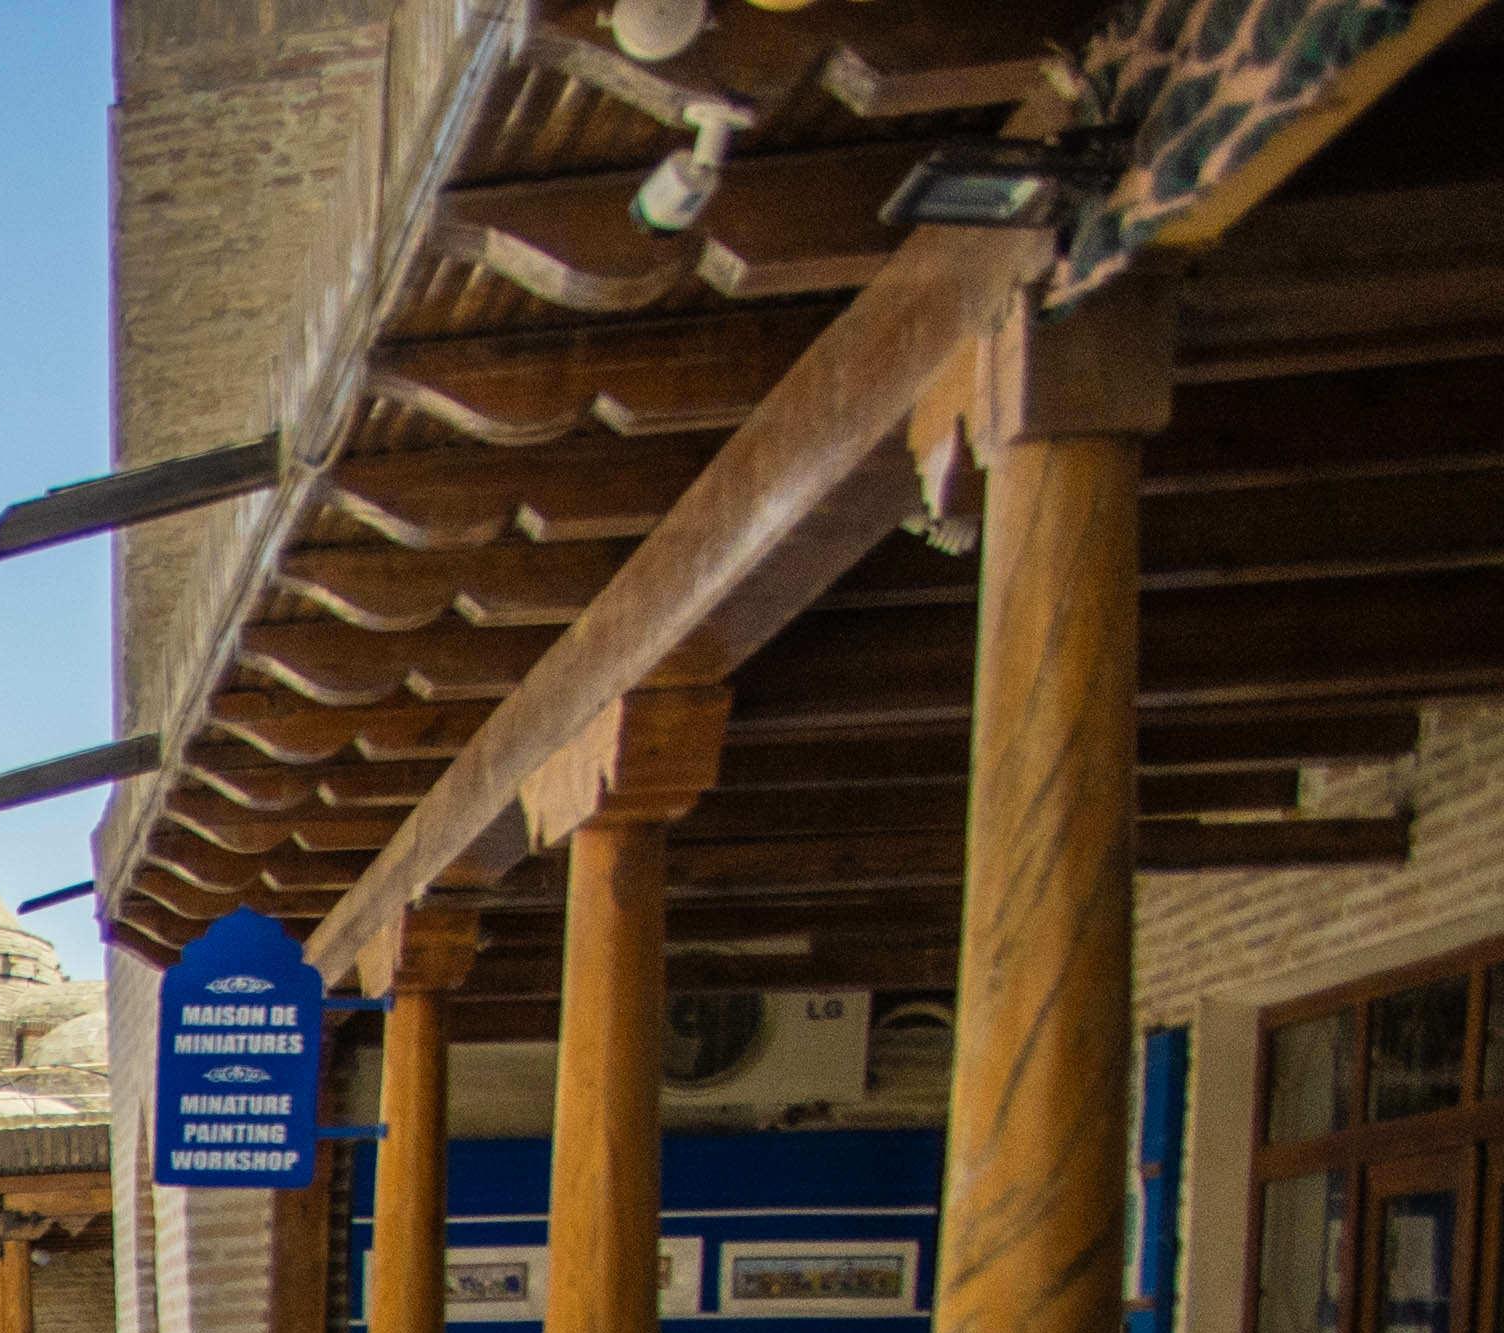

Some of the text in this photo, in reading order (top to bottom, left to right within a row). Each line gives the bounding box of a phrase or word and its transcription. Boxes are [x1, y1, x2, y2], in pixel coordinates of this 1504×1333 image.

[181, 1005, 297, 1027] MAISON DE
[806, 999, 843, 1020] LG
[174, 1033, 304, 1055] MINIATURES
[180, 1095, 292, 1115] MINATURE
[183, 1124, 287, 1143] PAINTING
[171, 1150, 300, 1172] WORKSHOP
